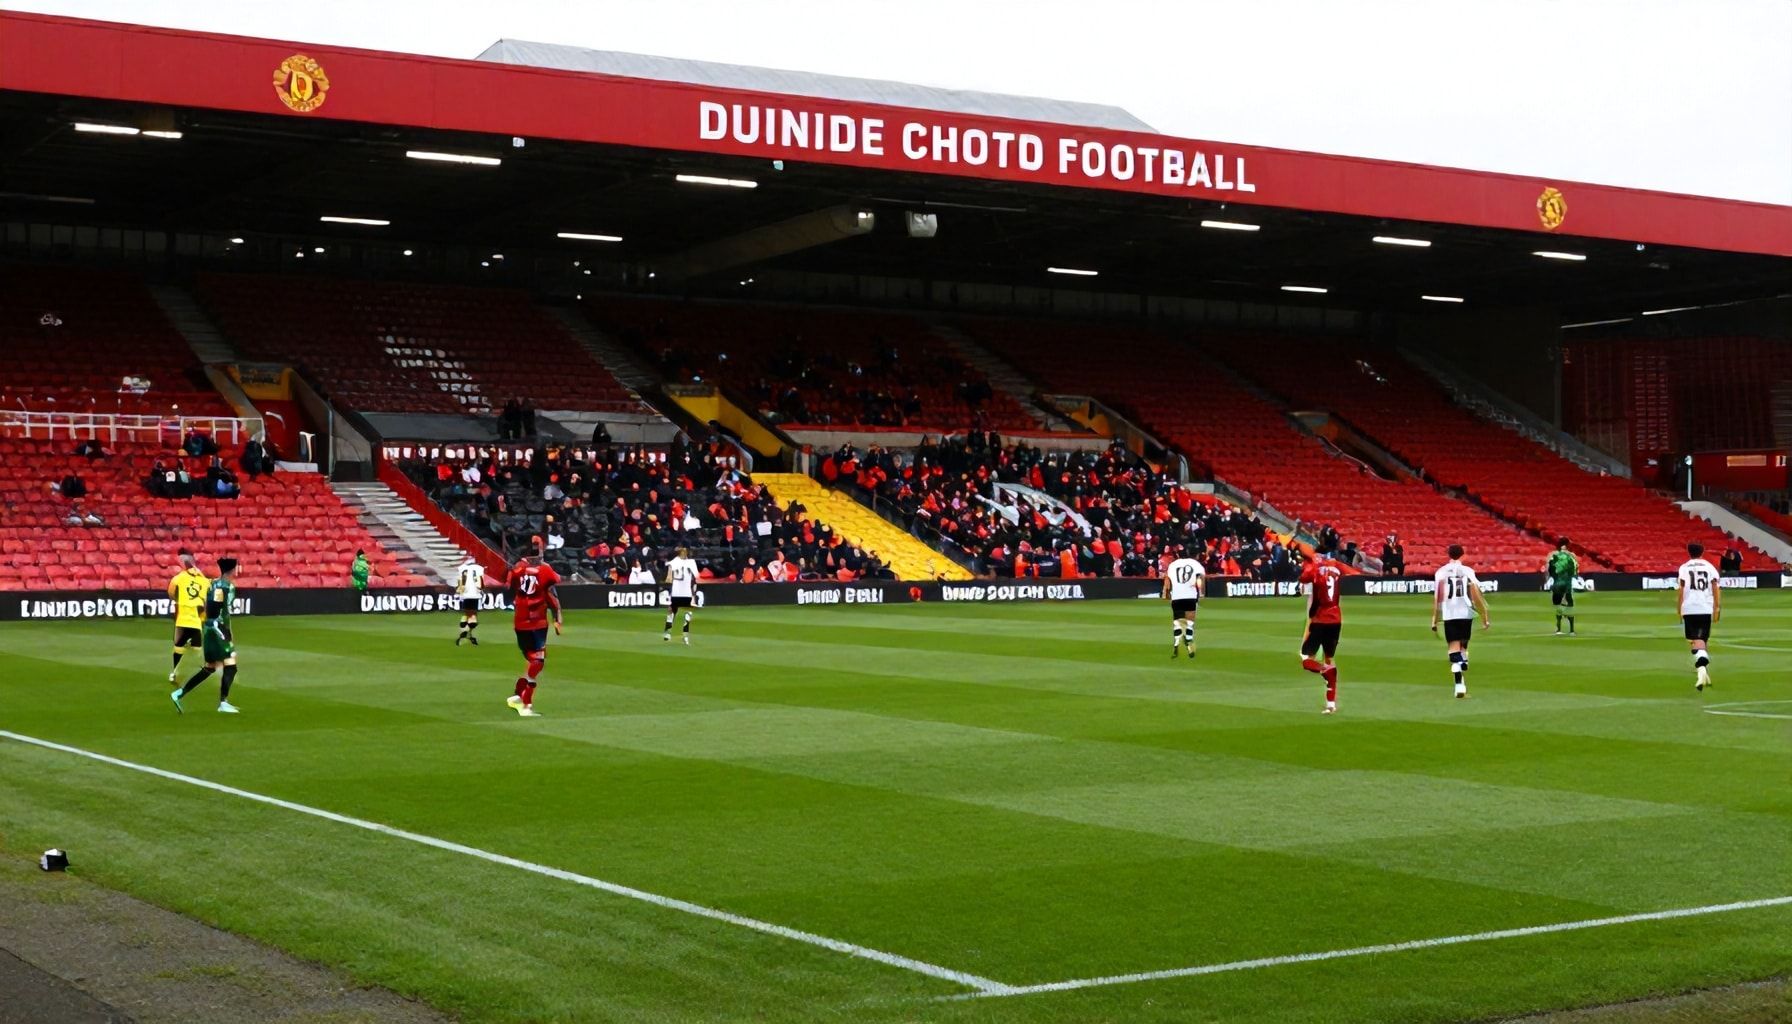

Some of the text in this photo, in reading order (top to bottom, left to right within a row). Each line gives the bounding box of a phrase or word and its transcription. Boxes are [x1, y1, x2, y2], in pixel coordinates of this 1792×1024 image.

[700, 101, 1256, 193] DUINIDE CHOTD FOOTBALL
